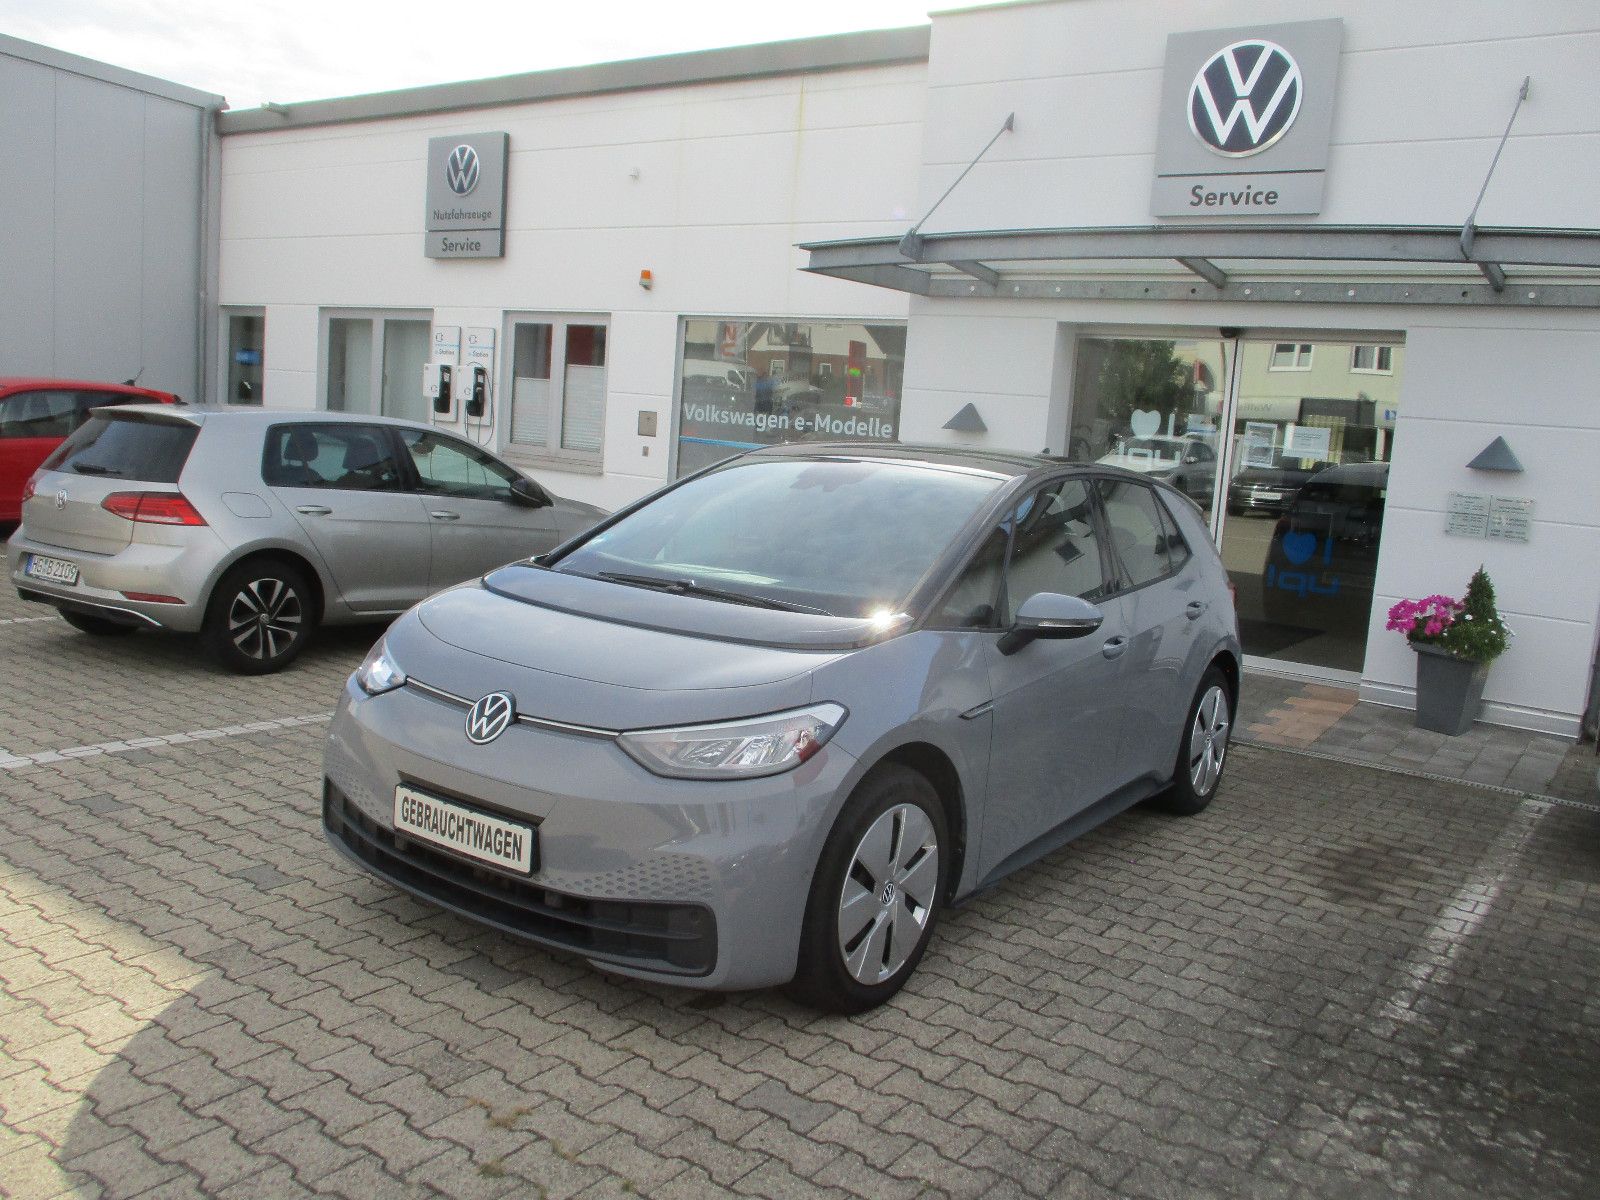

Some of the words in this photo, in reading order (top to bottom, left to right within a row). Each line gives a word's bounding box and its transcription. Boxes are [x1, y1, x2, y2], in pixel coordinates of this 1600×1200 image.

[1190, 184, 1279, 207] Service
[433, 208, 492, 221] Nutzfahrzeuge
[441, 237, 481, 252] Service
[683, 403, 789, 432] Volkswagen
[794, 414, 893, 439] e-Modelle
[401, 796, 523, 862] GEBRAUCHTWAGEN
